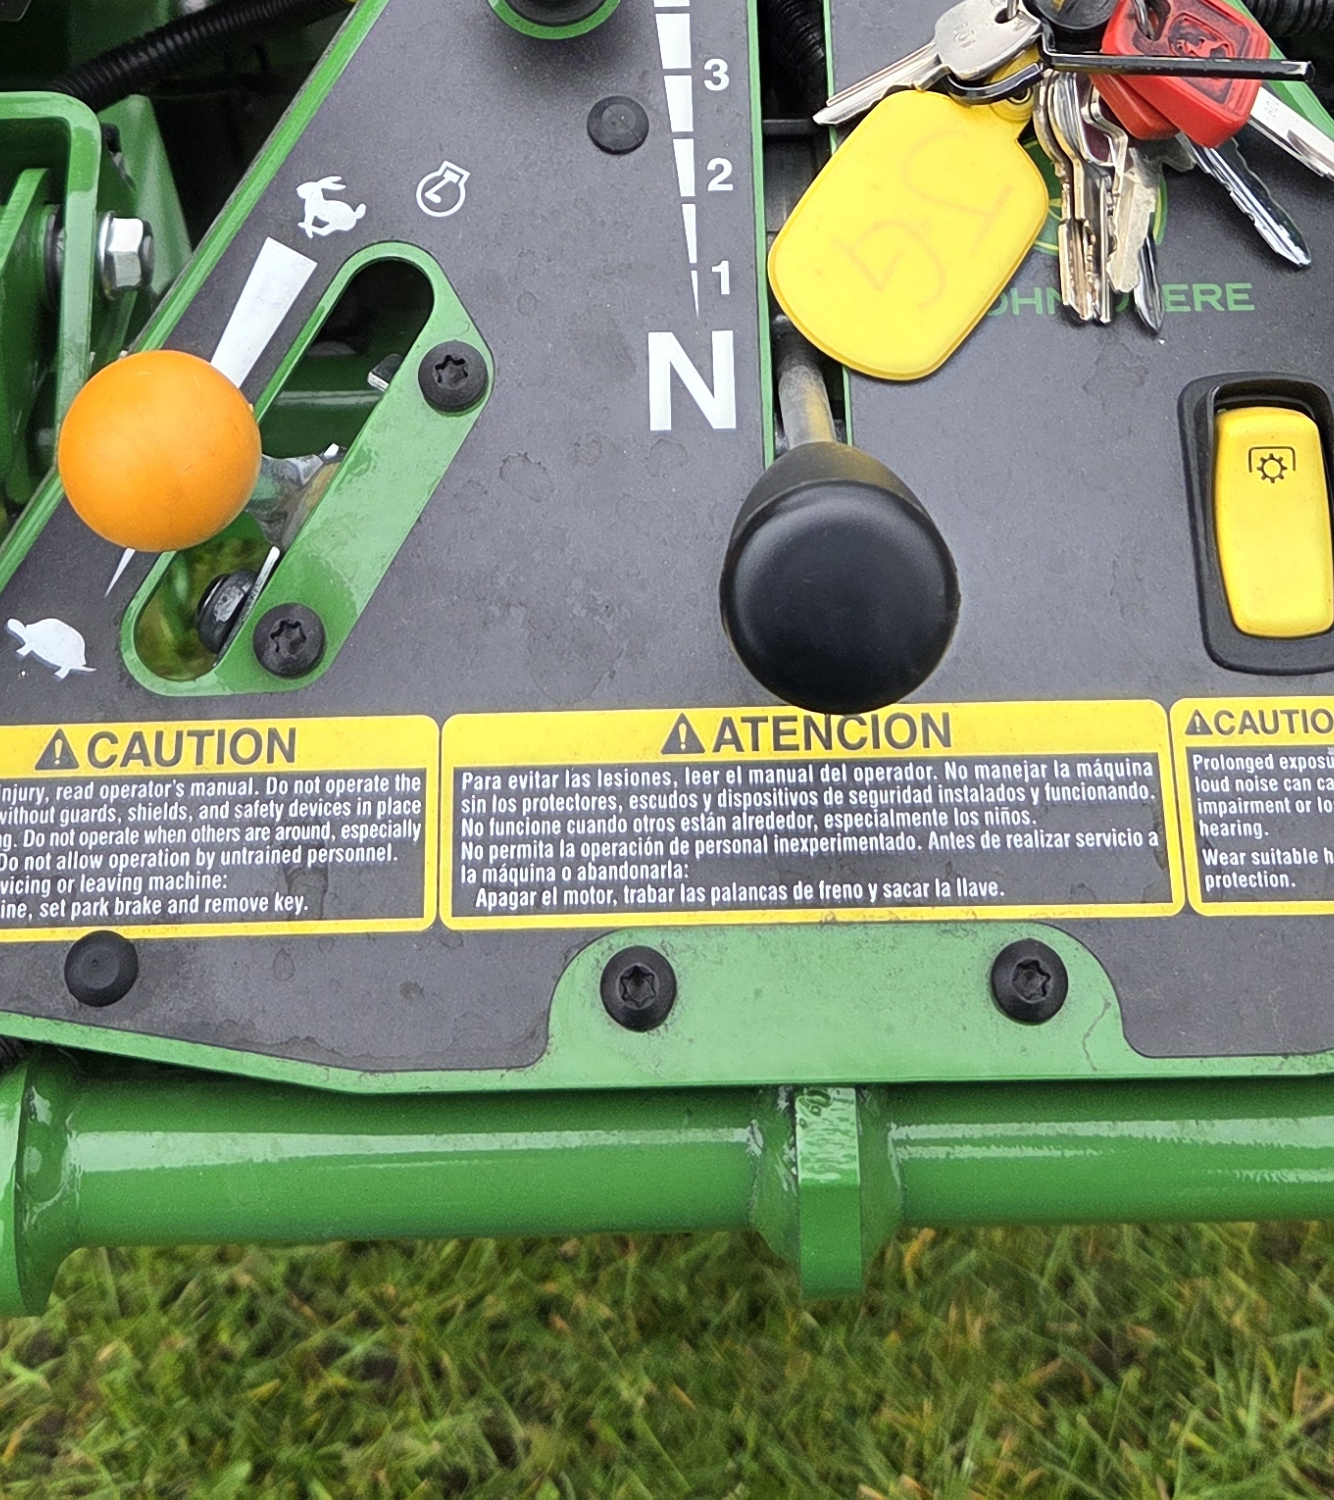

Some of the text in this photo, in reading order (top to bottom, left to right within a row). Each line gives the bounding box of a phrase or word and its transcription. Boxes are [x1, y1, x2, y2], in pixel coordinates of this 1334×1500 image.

[703, 59, 730, 91] 3
[707, 158, 733, 191] 2
[712, 261, 730, 295] 1
[648, 329, 737, 431] N
[86, 727, 297, 769] CAUTION
[712, 712, 951, 753] ATENCION
[461, 757, 1153, 791] Para evitar las lesiones, leer el manual del operador. No manejar la máquina
[1192, 752, 1275, 774] Prolonged
[55, 780, 94, 801] read
[189, 776, 259, 797] manual.
[265, 775, 288, 796] Do
[293, 775, 321, 795] not
[324, 773, 390, 798] operate
[394, 772, 421, 793] the
[460, 780, 1156, 817] sin los protectores, escudos y dispositivos de seguridad instalados y funcionando.
[1194, 775, 1230, 793] loud
[1234, 774, 1279, 793] noise
[1283, 777, 1312, 792] can
[59, 803, 122, 828] guards,
[127, 800, 193, 823] shields,
[198, 799, 230, 821] and
[233, 799, 285, 823] safety
[288, 798, 352, 818] devices
[355, 800, 372, 816] in
[376, 795, 422, 820] place
[461, 817, 484, 838] No
[488, 815, 561, 837] funcione
[566, 813, 628, 835] cuando
[632, 813, 676, 834] otros
[823, 807, 949, 833] especialmente
[953, 806, 979, 827] los
[984, 806, 1037, 826] niños.
[1196, 796, 1291, 818] impairment
[1294, 799, 1312, 814] or
[22, 828, 46, 848] Do
[49, 827, 76, 847] not
[78, 825, 140, 851] operate
[143, 824, 187, 845] when
[190, 823, 241, 844] others
[244, 825, 271, 842] are
[274, 819, 336, 842] around,
[340, 817, 422, 844] especially
[1198, 818, 1269, 840] hearing.
[23, 851, 52, 871] not
[55, 850, 104, 871] allow
[108, 847, 190, 874] operation
[194, 846, 216, 871] by
[220, 844, 302, 866] untrained
[306, 842, 398, 868] personnel.
[1201, 847, 1246, 866] Wear
[1250, 846, 1319, 866] suitable
[56, 877, 76, 894] or
[79, 872, 143, 896] leaving
[148, 870, 228, 891] machine:
[460, 858, 689, 887] la máquina o abandonarla:
[1204, 869, 1296, 893] protection.
[38, 898, 66, 918] set
[70, 896, 109, 922] park
[113, 894, 162, 916] brake
[166, 893, 199, 915] and
[203, 896, 269, 914] remove
[273, 891, 308, 916] key.
[475, 876, 1005, 912] Apagar el motor, trabar las palancas de freno y sacar la llave.
